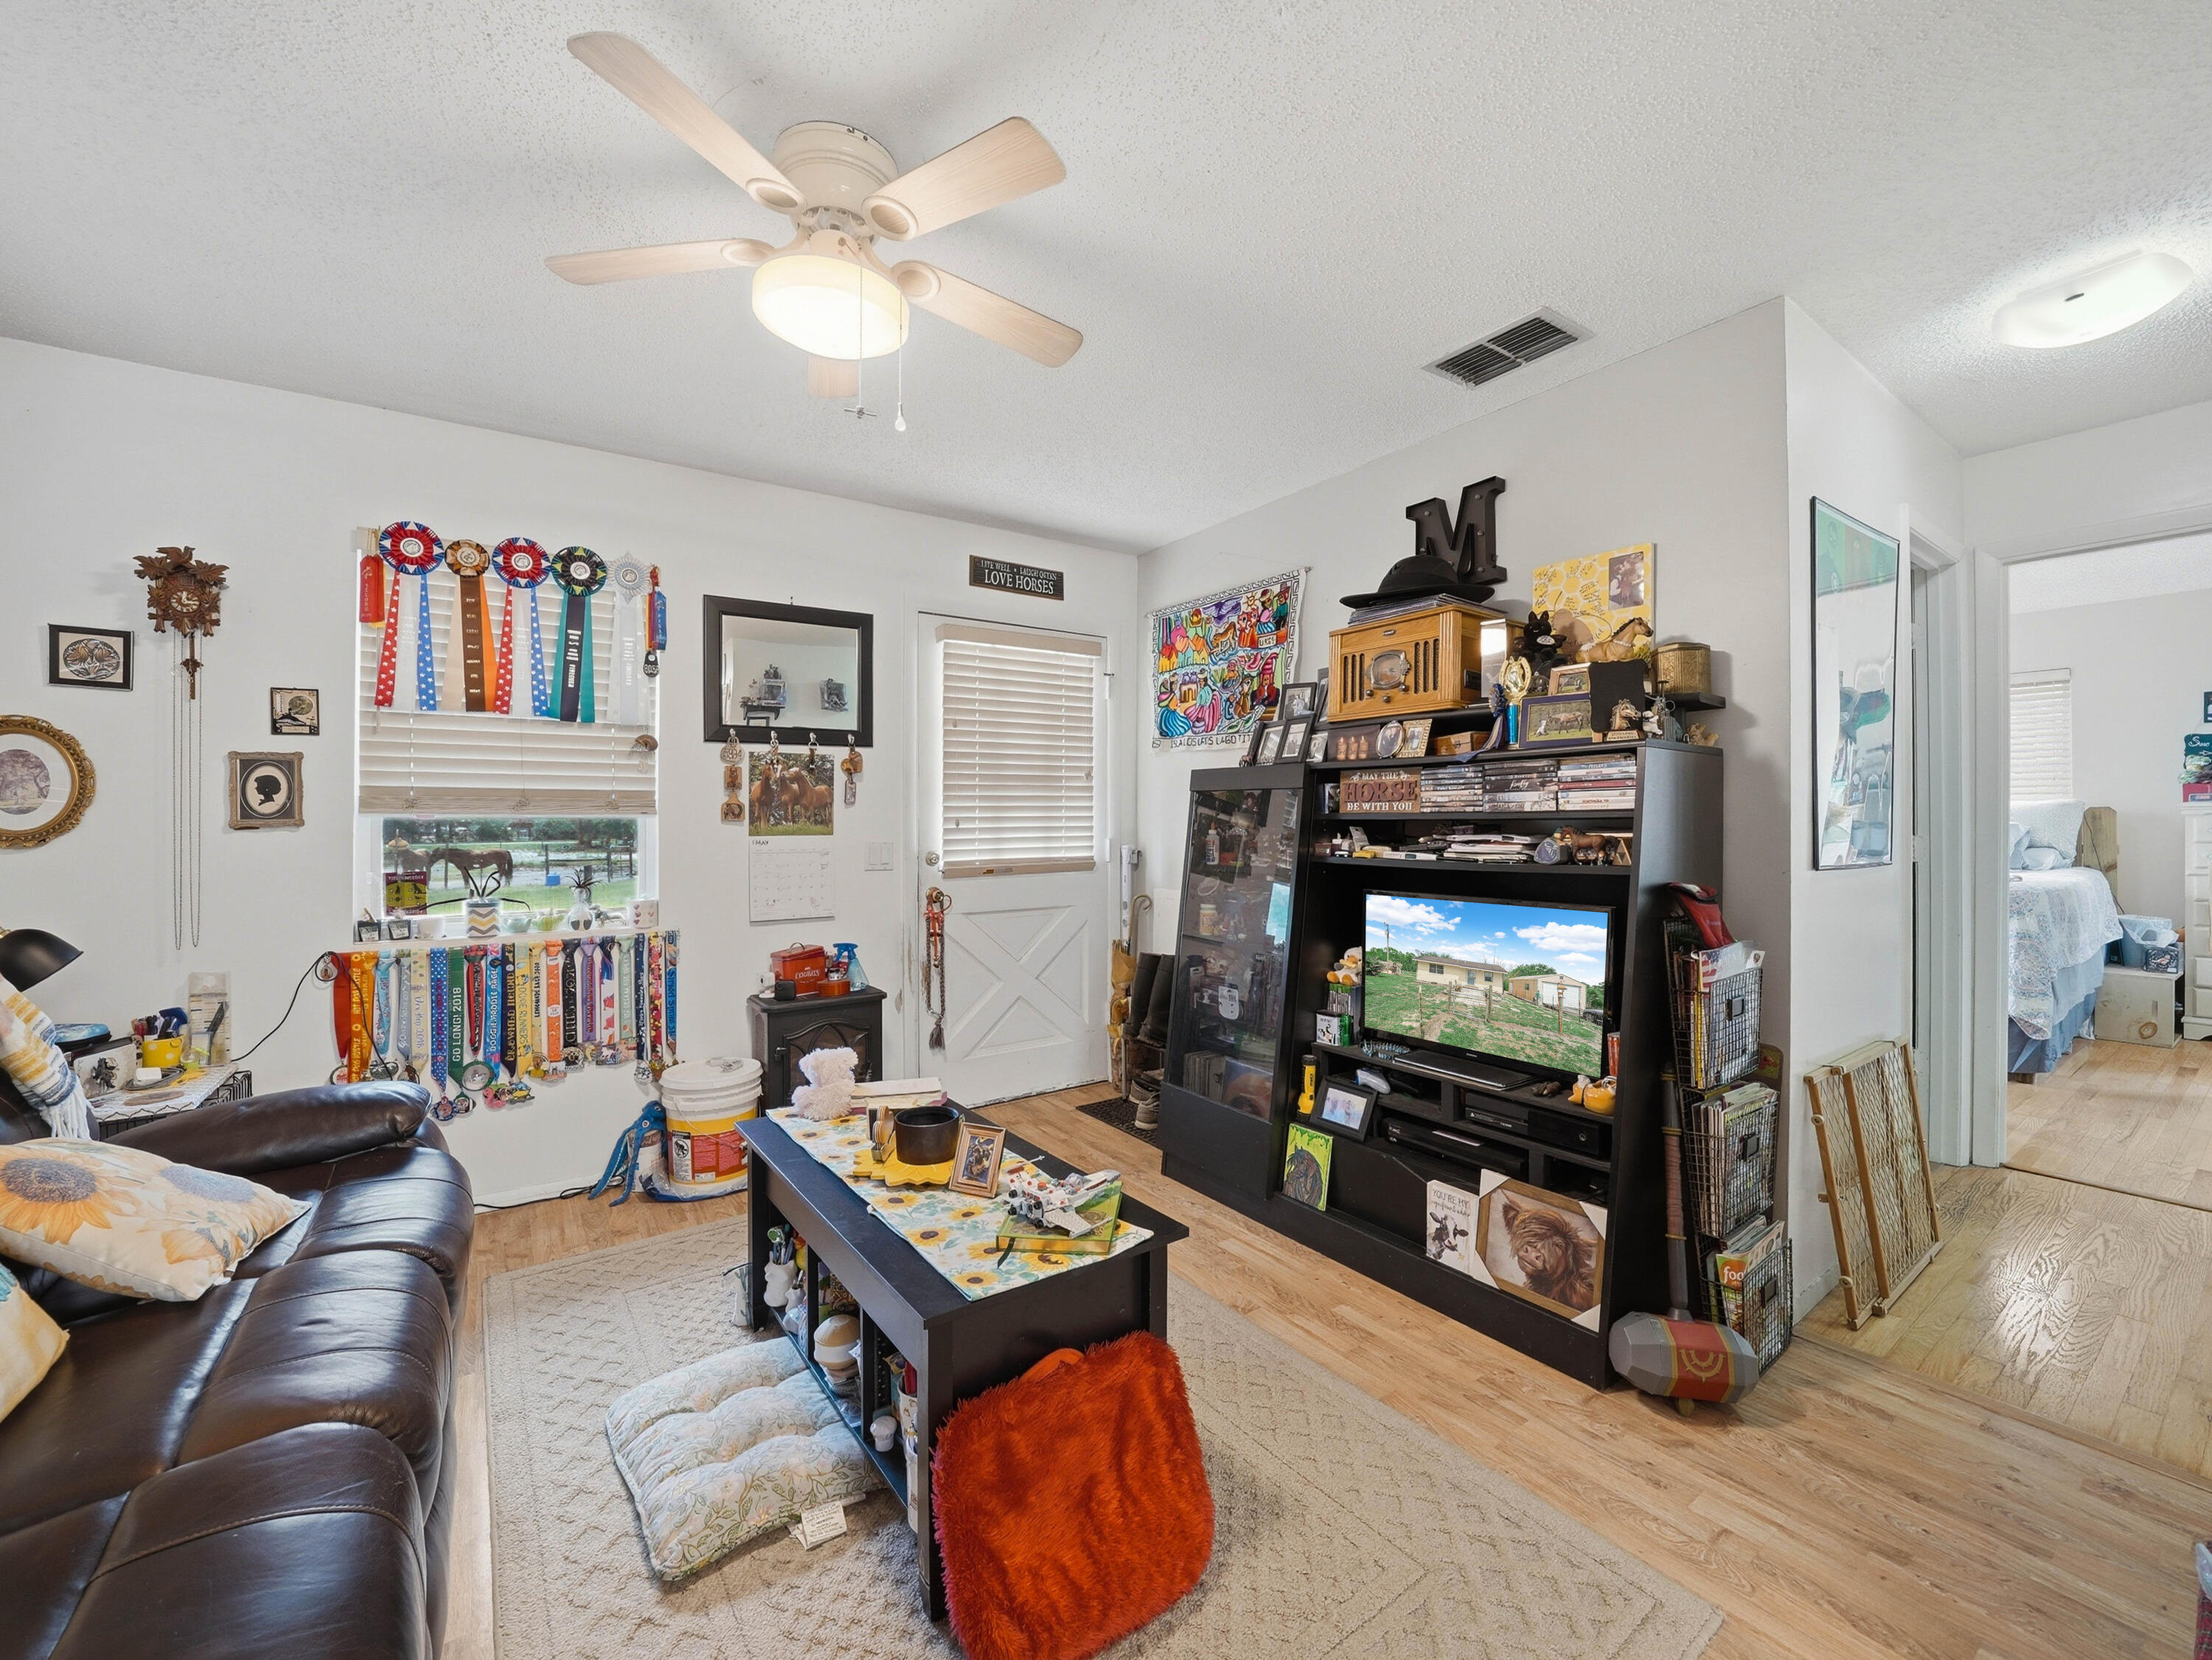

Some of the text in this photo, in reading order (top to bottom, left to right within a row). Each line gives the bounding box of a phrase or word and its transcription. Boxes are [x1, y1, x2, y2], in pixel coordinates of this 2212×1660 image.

[1405, 475, 1507, 584] M
[995, 562, 1011, 573] WELL
[1020, 567, 1038, 577] LAUGH
[985, 569, 1054, 594] LOVE HORSES
[1362, 771, 1399, 780] MAY THE
[1342, 780, 1418, 803] HORSE
[1347, 801, 1412, 811] BE WITH YOU
[452, 986, 462, 1062] GO LONG! 2018
